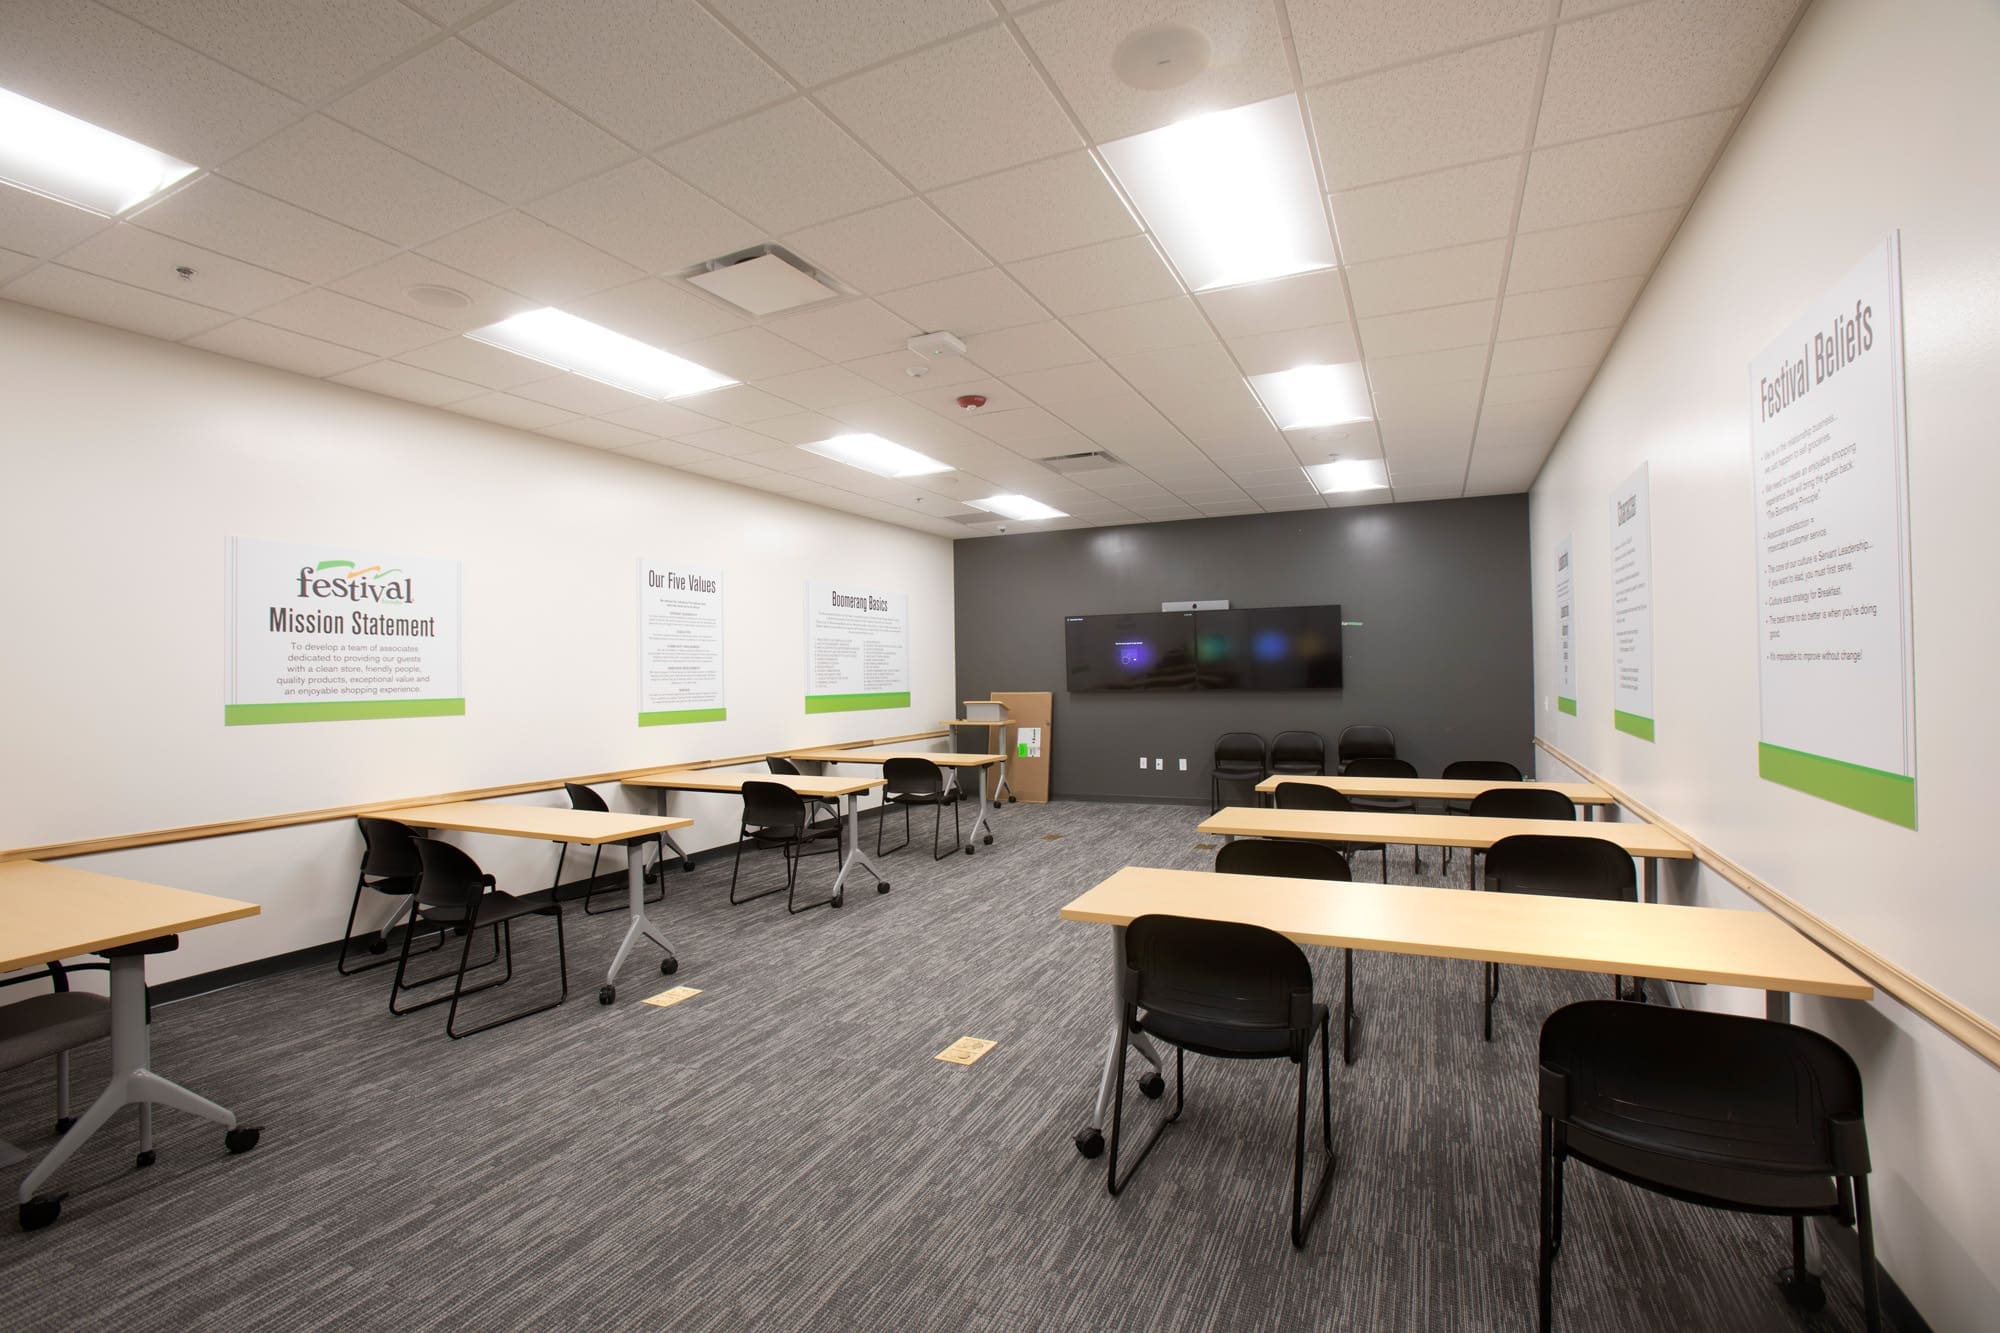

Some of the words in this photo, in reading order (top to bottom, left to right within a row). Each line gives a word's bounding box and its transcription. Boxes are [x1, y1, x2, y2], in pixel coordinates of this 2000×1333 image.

[1760, 343, 1809, 423] Festival
[1814, 299, 1873, 385] Beliefs
[1832, 442, 1856, 462] shopping
[1818, 549, 1837, 561] Servant
[296, 566, 414, 604] festival
[648, 569, 664, 589] Our
[668, 572, 686, 591] Five
[689, 574, 716, 594] Values
[832, 590, 867, 612] Boomerang
[869, 595, 888, 612] Basics
[1860, 604, 1877, 617] doing
[269, 606, 344, 634] Mission
[352, 610, 435, 637] Statement
[291, 642, 302, 650] To
[305, 642, 338, 653] develop
[348, 644, 368, 652] team
[370, 643, 378, 652] of
[379, 644, 419, 653] associates
[288, 654, 331, 662] dedicated
[344, 654, 380, 665] providing
[397, 655, 421, 665] guests
[287, 665, 305, 673] with
[316, 665, 338, 673] clean
[340, 666, 363, 674] store,
[365, 665, 392, 675] friendly
[276, 676, 305, 686] quality
[308, 675, 348, 685] products,
[350, 675, 393, 685] exceptional
[396, 675, 414, 683] value
[416, 675, 430, 683] and
[284, 688, 295, 696] an
[298, 686, 338, 697] enjoyable
[341, 686, 378, 695] shopping
[380, 685, 422, 695] experience.
